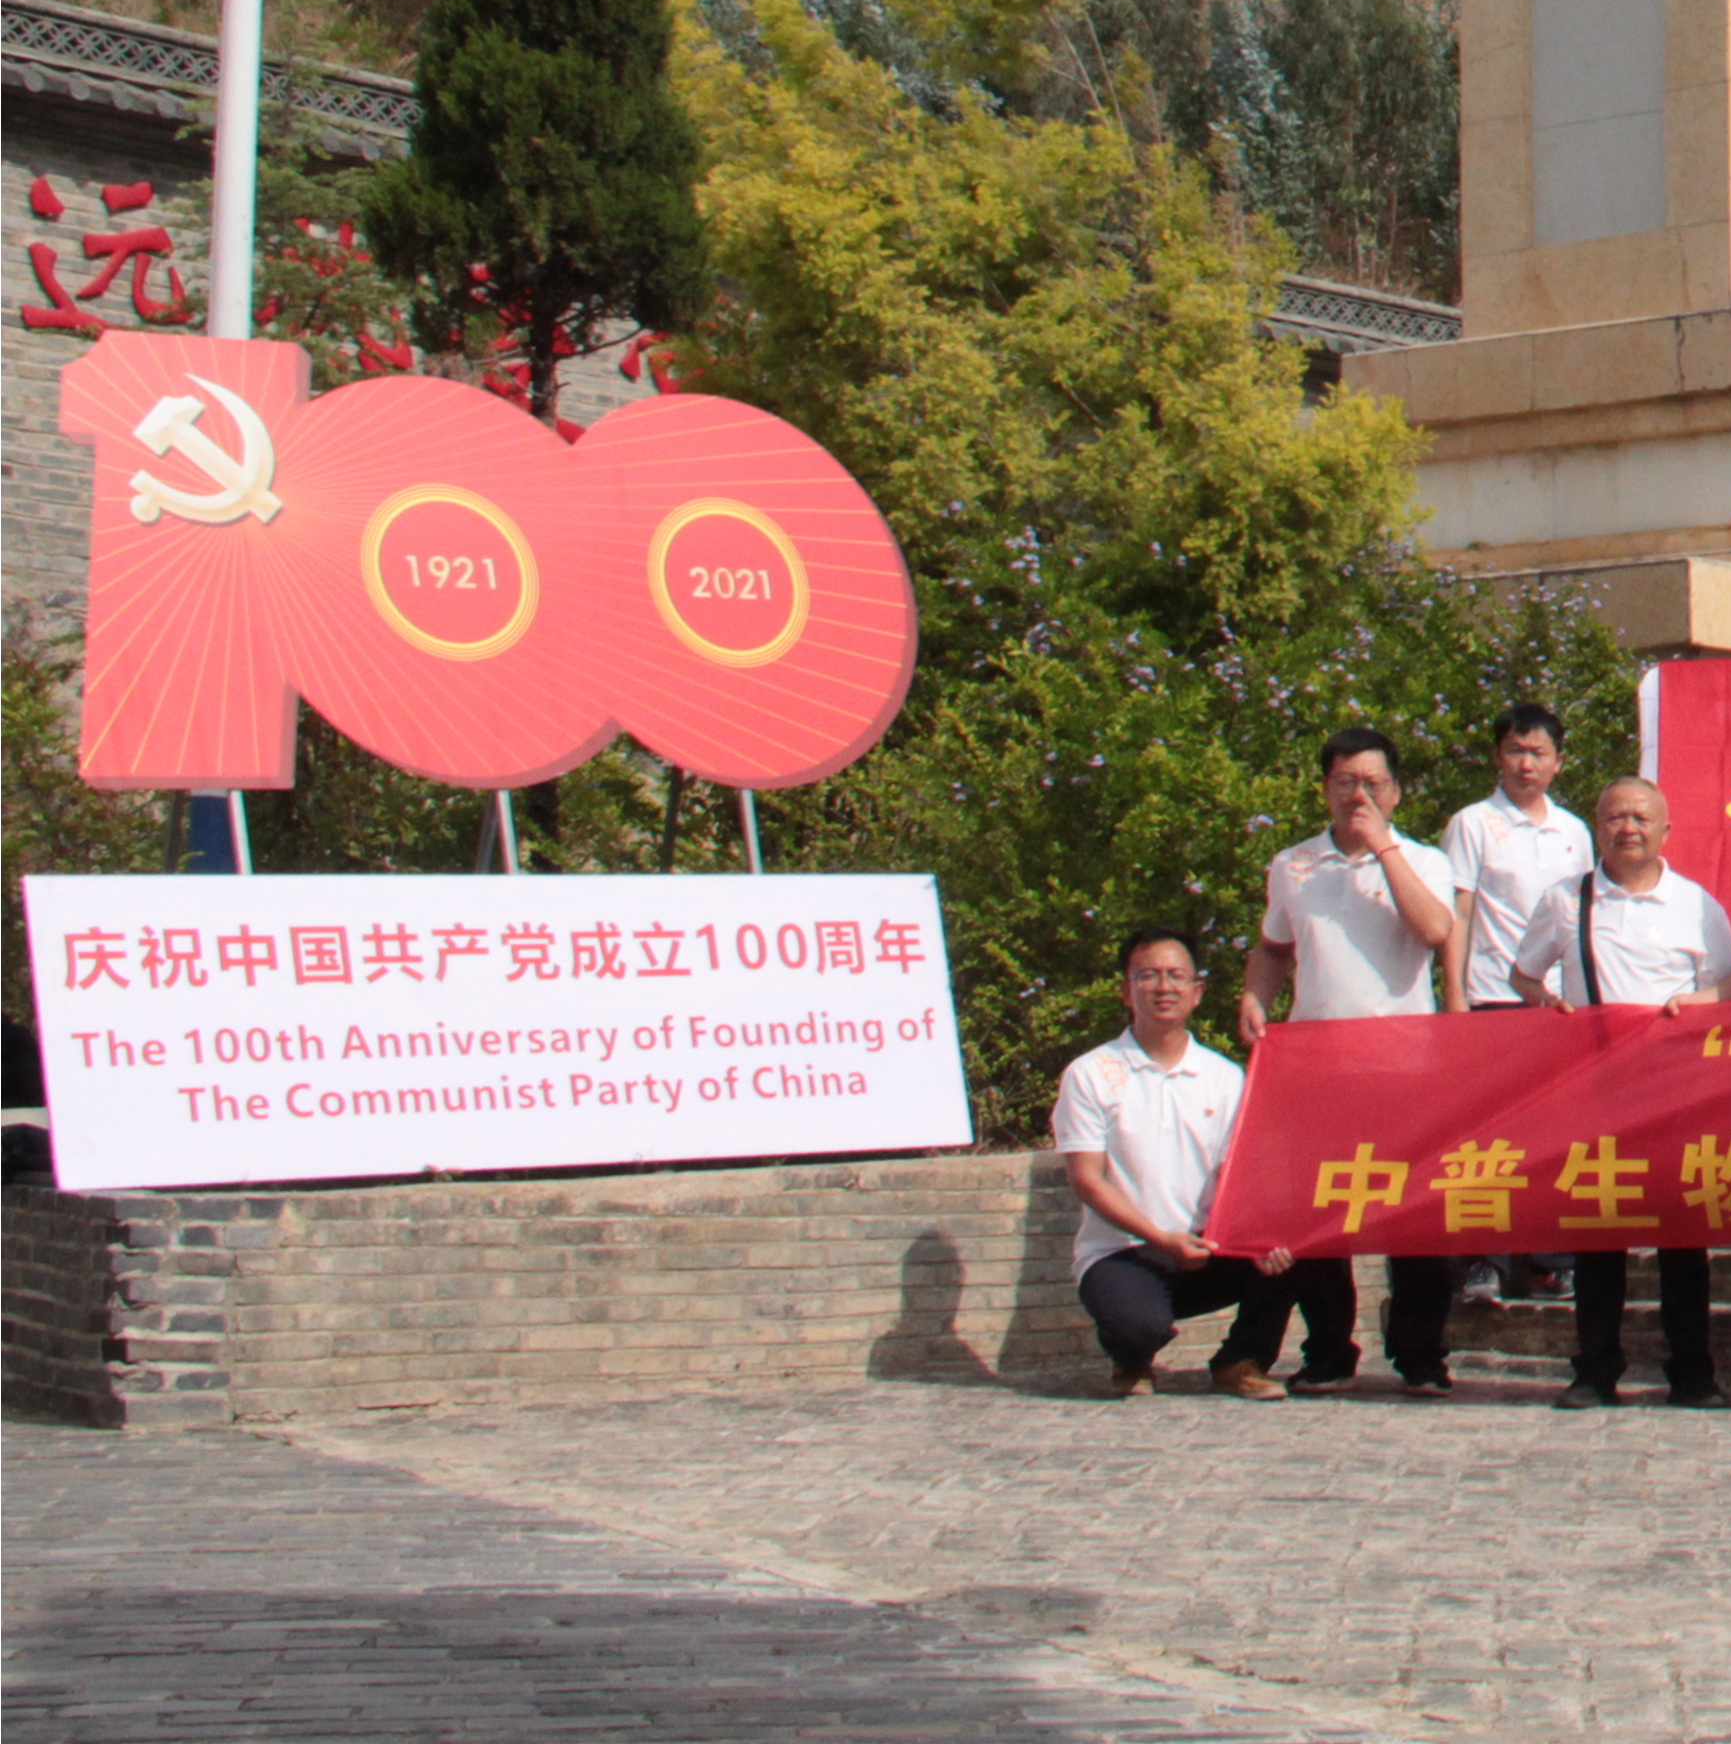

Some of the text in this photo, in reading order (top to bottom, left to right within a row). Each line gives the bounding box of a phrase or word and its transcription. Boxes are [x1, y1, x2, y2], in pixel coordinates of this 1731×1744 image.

[405, 555, 497, 590] 1921
[689, 566, 771, 600] 2021
[64, 918, 926, 990] 庆祝中国共产党成立100周年
[72, 1007, 936, 1068] The 100th Anniversary of Founding of
[178, 1064, 867, 1122] The Communist Party of China
